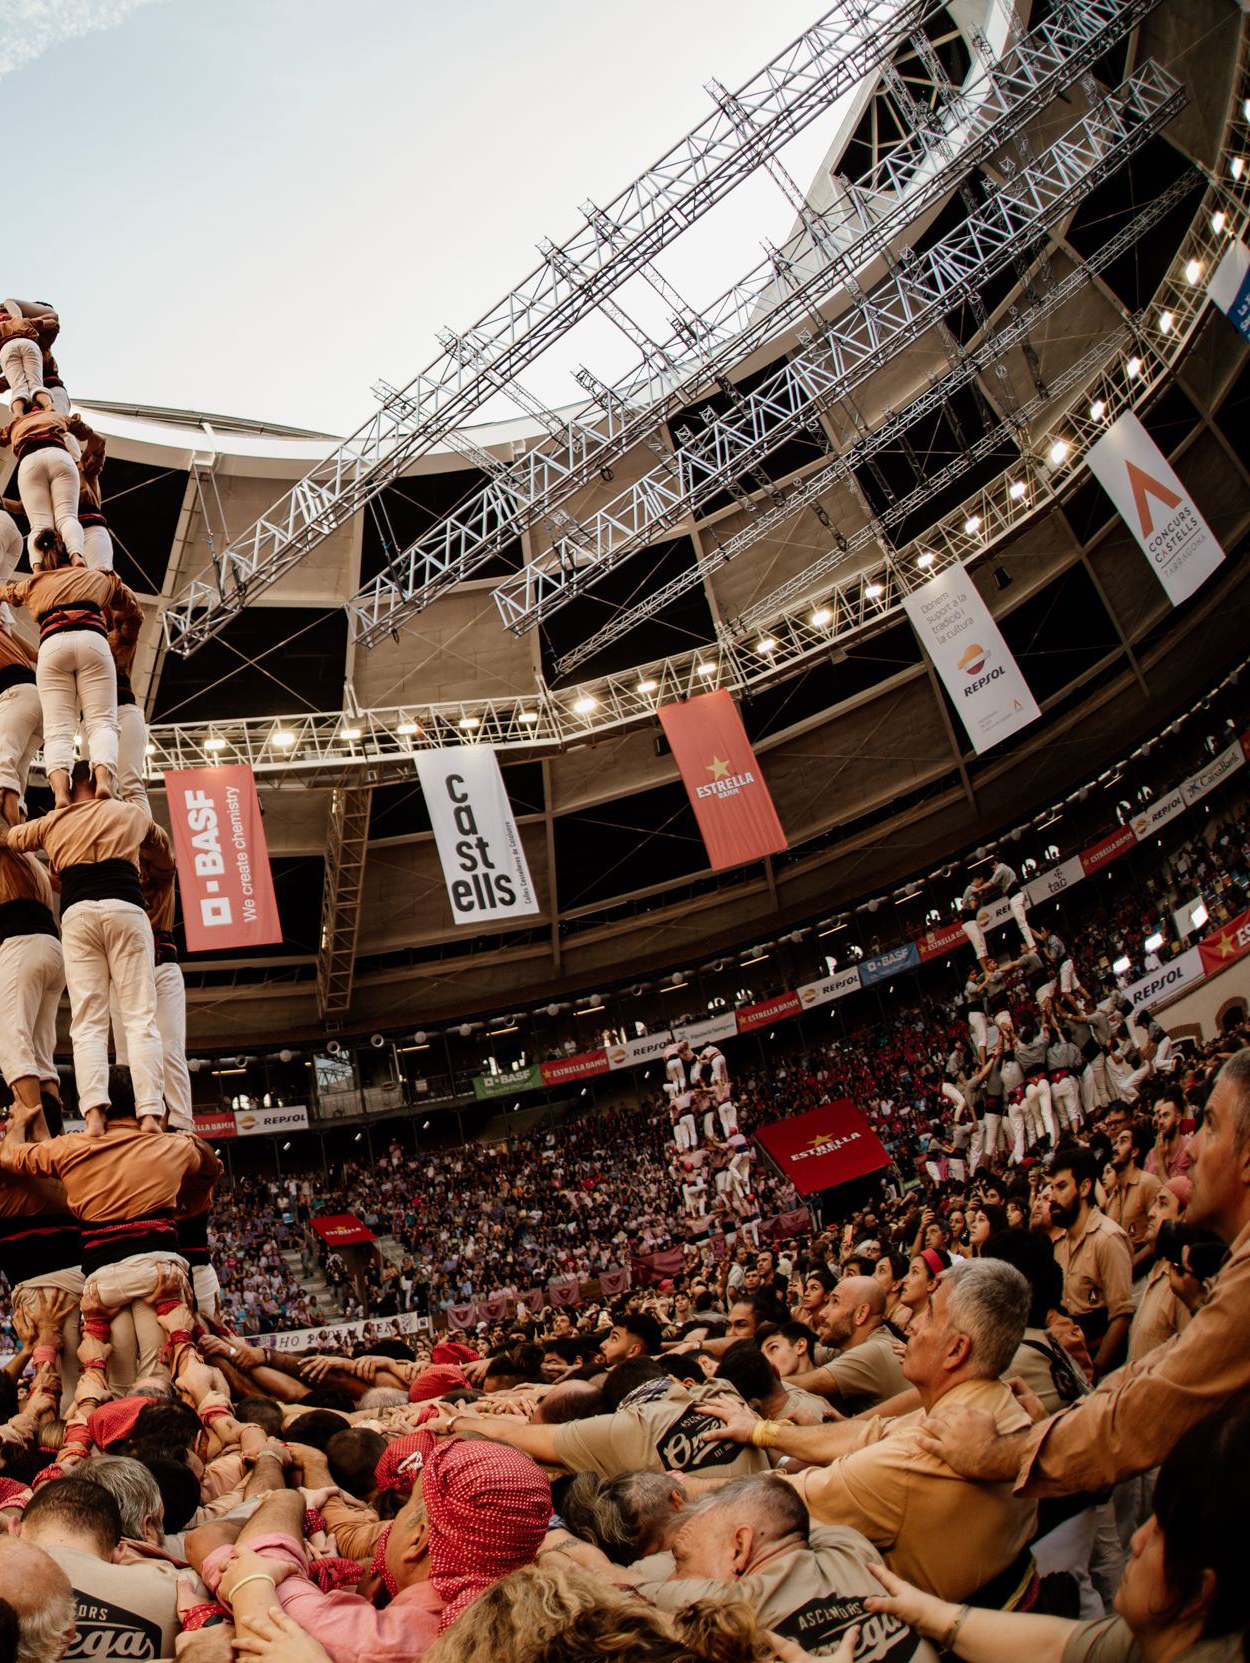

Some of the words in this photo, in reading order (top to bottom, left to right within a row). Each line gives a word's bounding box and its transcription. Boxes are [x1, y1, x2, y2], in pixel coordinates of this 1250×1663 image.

[1149, 507, 1191, 552] CONCURS
[1155, 517, 1198, 563] CASTELLS
[1164, 534, 1207, 577] TARRAGONA
[920, 592, 949, 615] Donem
[926, 604, 952, 624] suport
[952, 598, 959, 608] a
[960, 593, 967, 603] la
[932, 611, 961, 634] tradició
[937, 634, 946, 645] la
[946, 617, 975, 640] cultura
[963, 666, 1006, 697] REPSOL
[1199, 752, 1239, 787] CaixaBank
[696, 772, 755, 799] ESTRELLA
[718, 788, 739, 799] DAMM
[226, 786, 247, 849] chemistry
[1151, 797, 1182, 821] REPSOL
[184, 789, 225, 876] BASF
[1090, 845, 1117, 864] ESTRELLA
[236, 851, 253, 895] create
[241, 897, 258, 923] We
[927, 933, 957, 951] ESTRELLA
[882, 948, 908, 966] BASF
[822, 975, 859, 995] REPSOL
[1133, 967, 1183, 1004] REPSOL
[748, 1007, 779, 1022] ESTRELLA
[778, 999, 799, 1011] DAMM
[633, 1041, 667, 1057] REPSO
[501, 1070, 531, 1083] BASF
[553, 1065, 585, 1078] ESTRELLA
[586, 1058, 607, 1070] DAMM
[211, 1121, 235, 1130] DAMM
[264, 1114, 306, 1125] REPSOL
[790, 1132, 861, 1161] ESTRELLA
[279, 1336, 299, 1349] HO
[63, 1630, 155, 1661] ega
